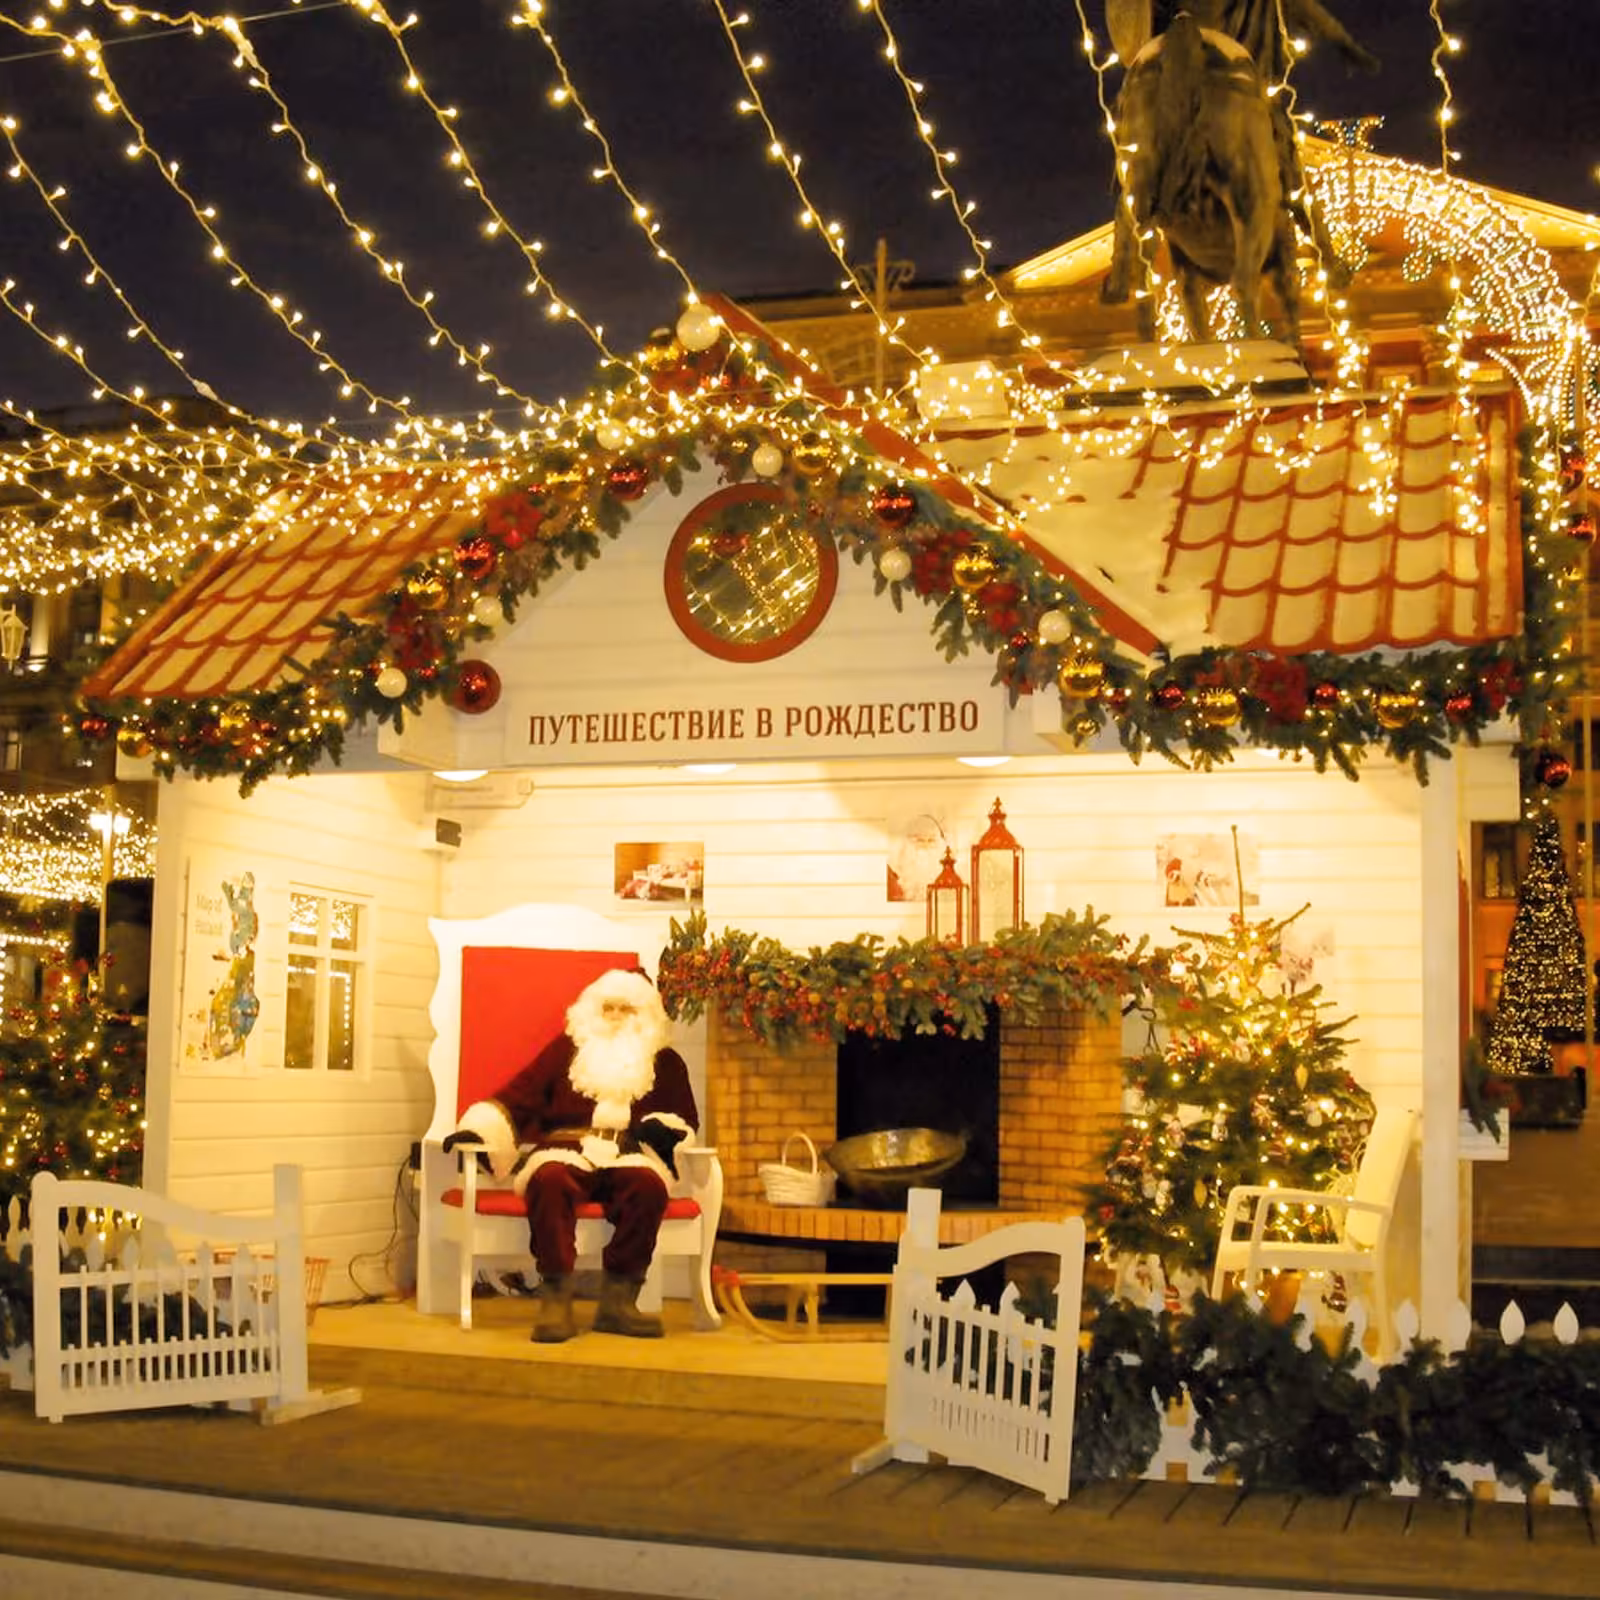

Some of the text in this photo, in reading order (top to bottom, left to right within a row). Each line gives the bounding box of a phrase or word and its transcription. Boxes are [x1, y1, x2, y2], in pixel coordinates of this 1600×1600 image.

[529, 700, 979, 745] ПУТЕШЕСТВИЕ В РОЖДЕСТВО
